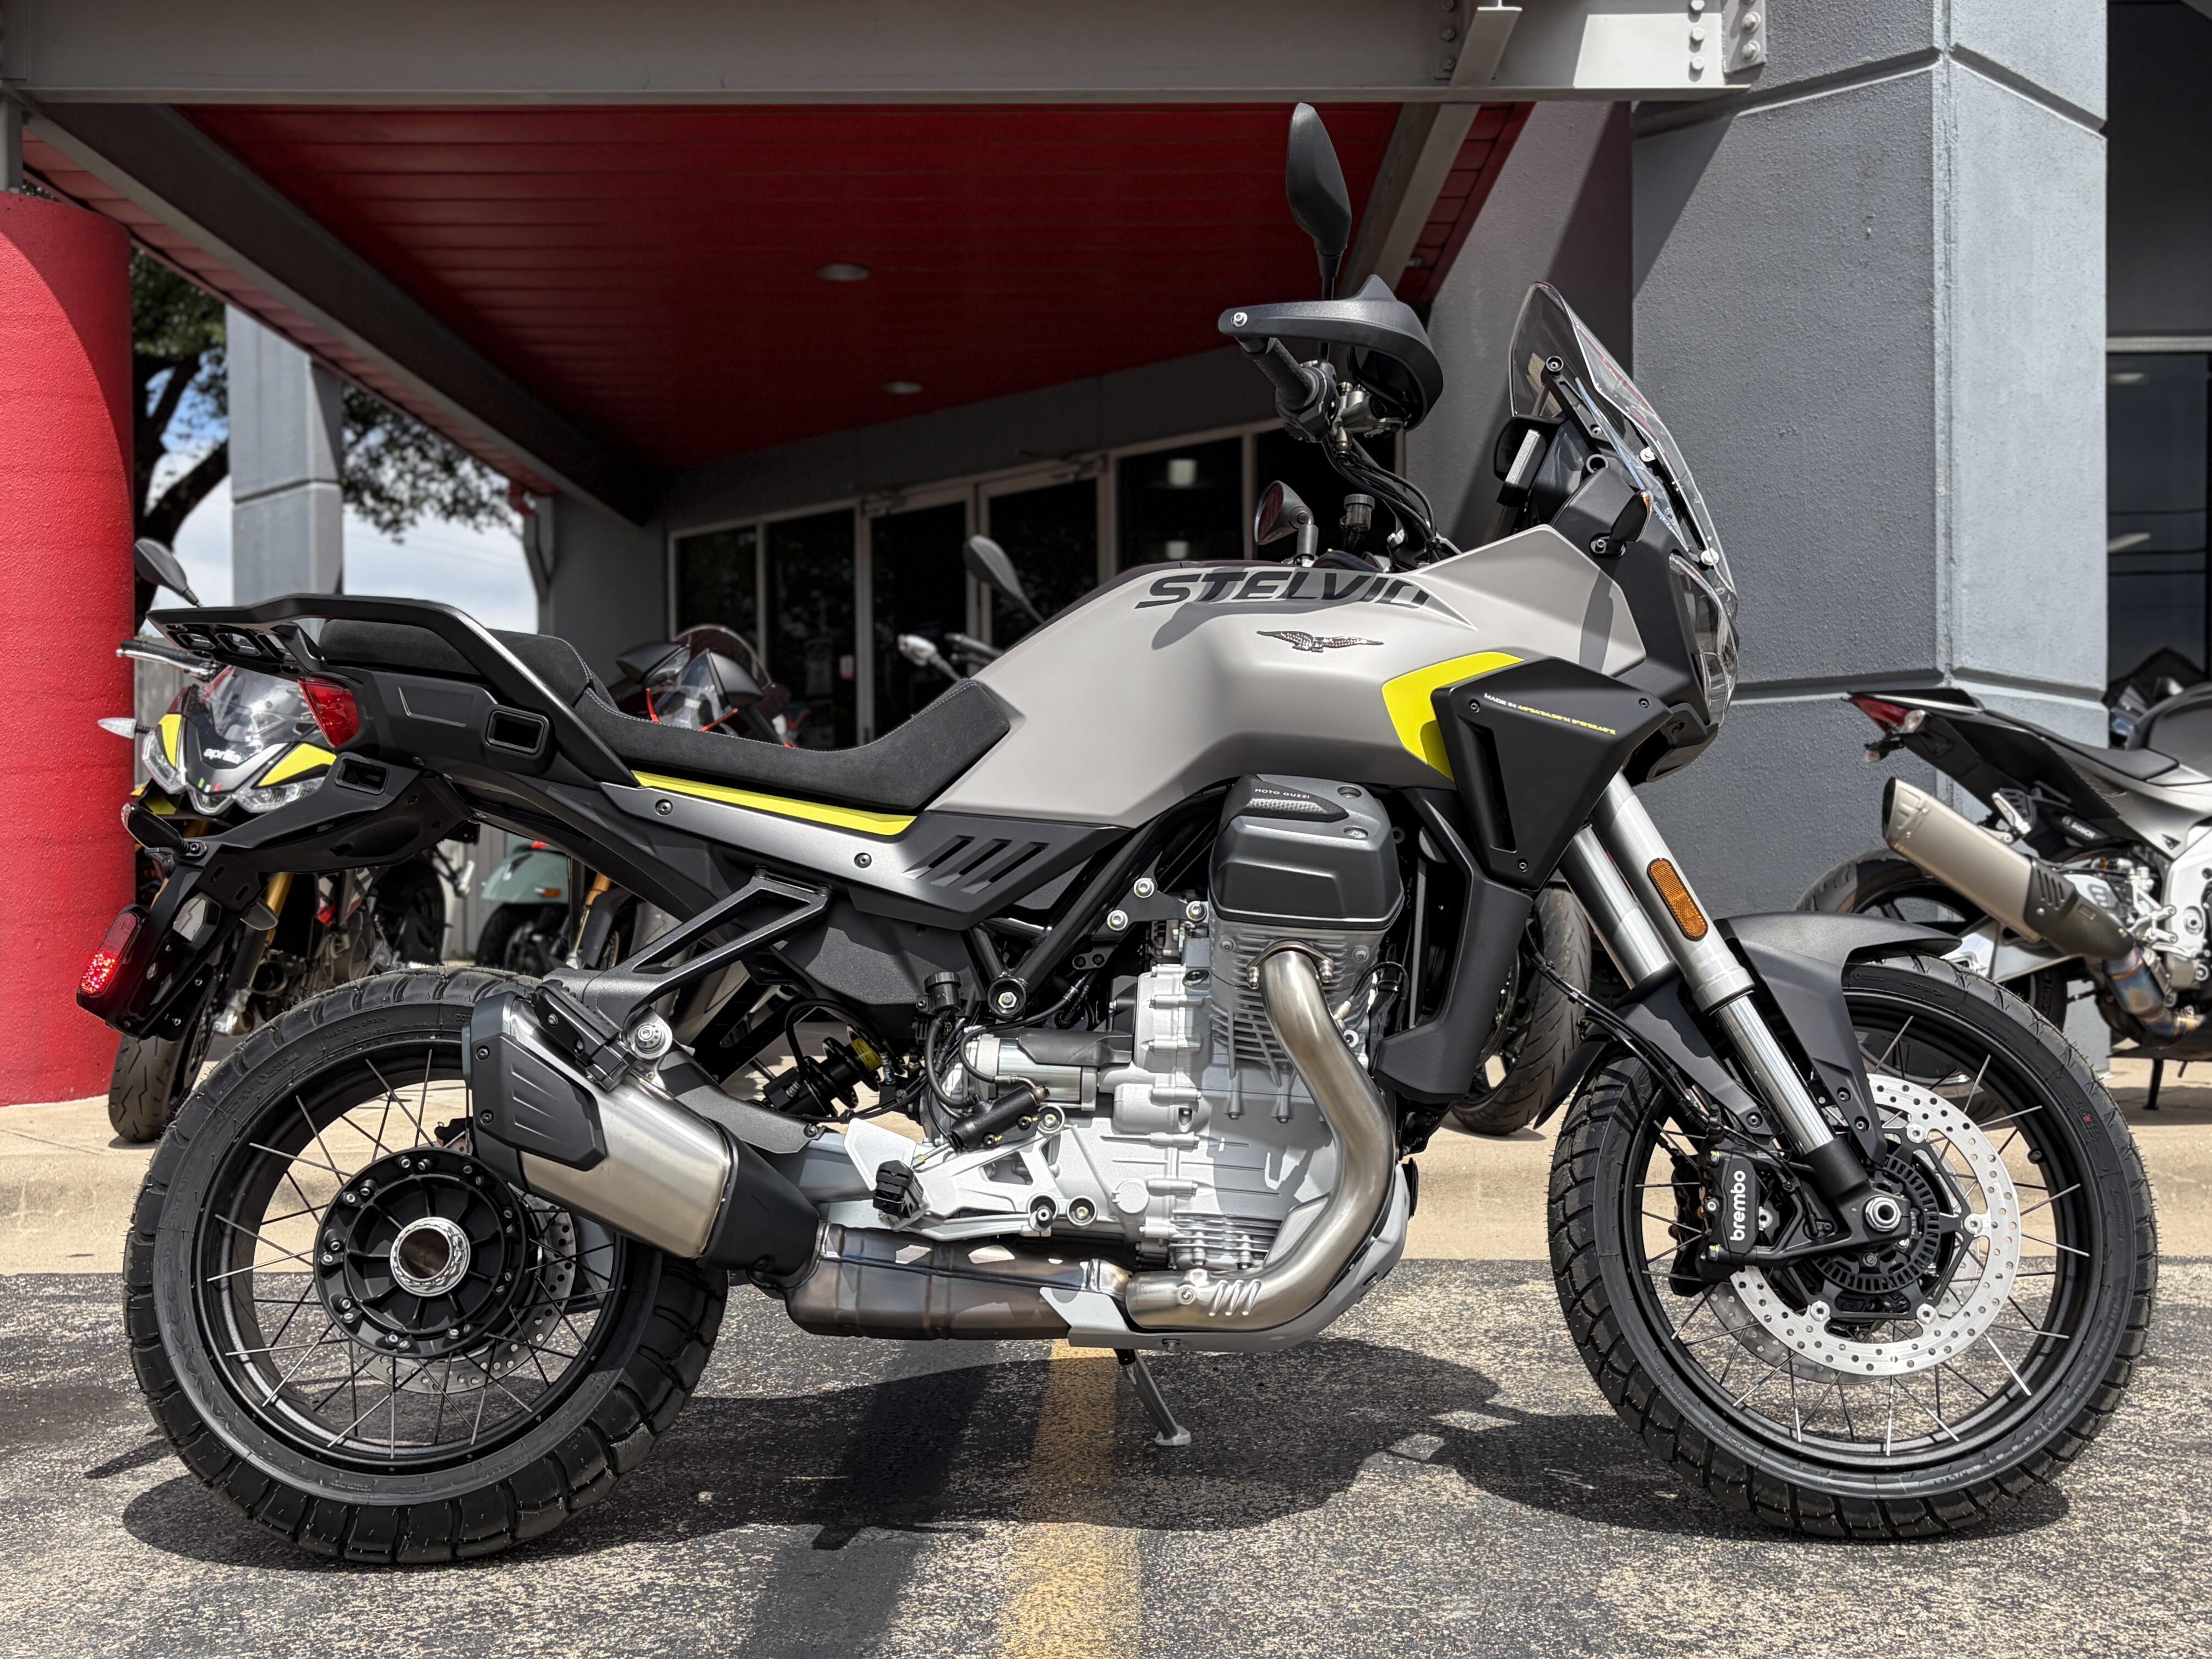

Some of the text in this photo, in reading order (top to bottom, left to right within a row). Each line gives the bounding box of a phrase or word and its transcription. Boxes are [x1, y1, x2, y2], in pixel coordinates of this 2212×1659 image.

[1134, 570, 1430, 609] STELVIO
[2071, 821, 2096, 839] BOSCH
[325, 1027, 349, 1040] MADE
[1730, 1170, 1746, 1241] brembo
